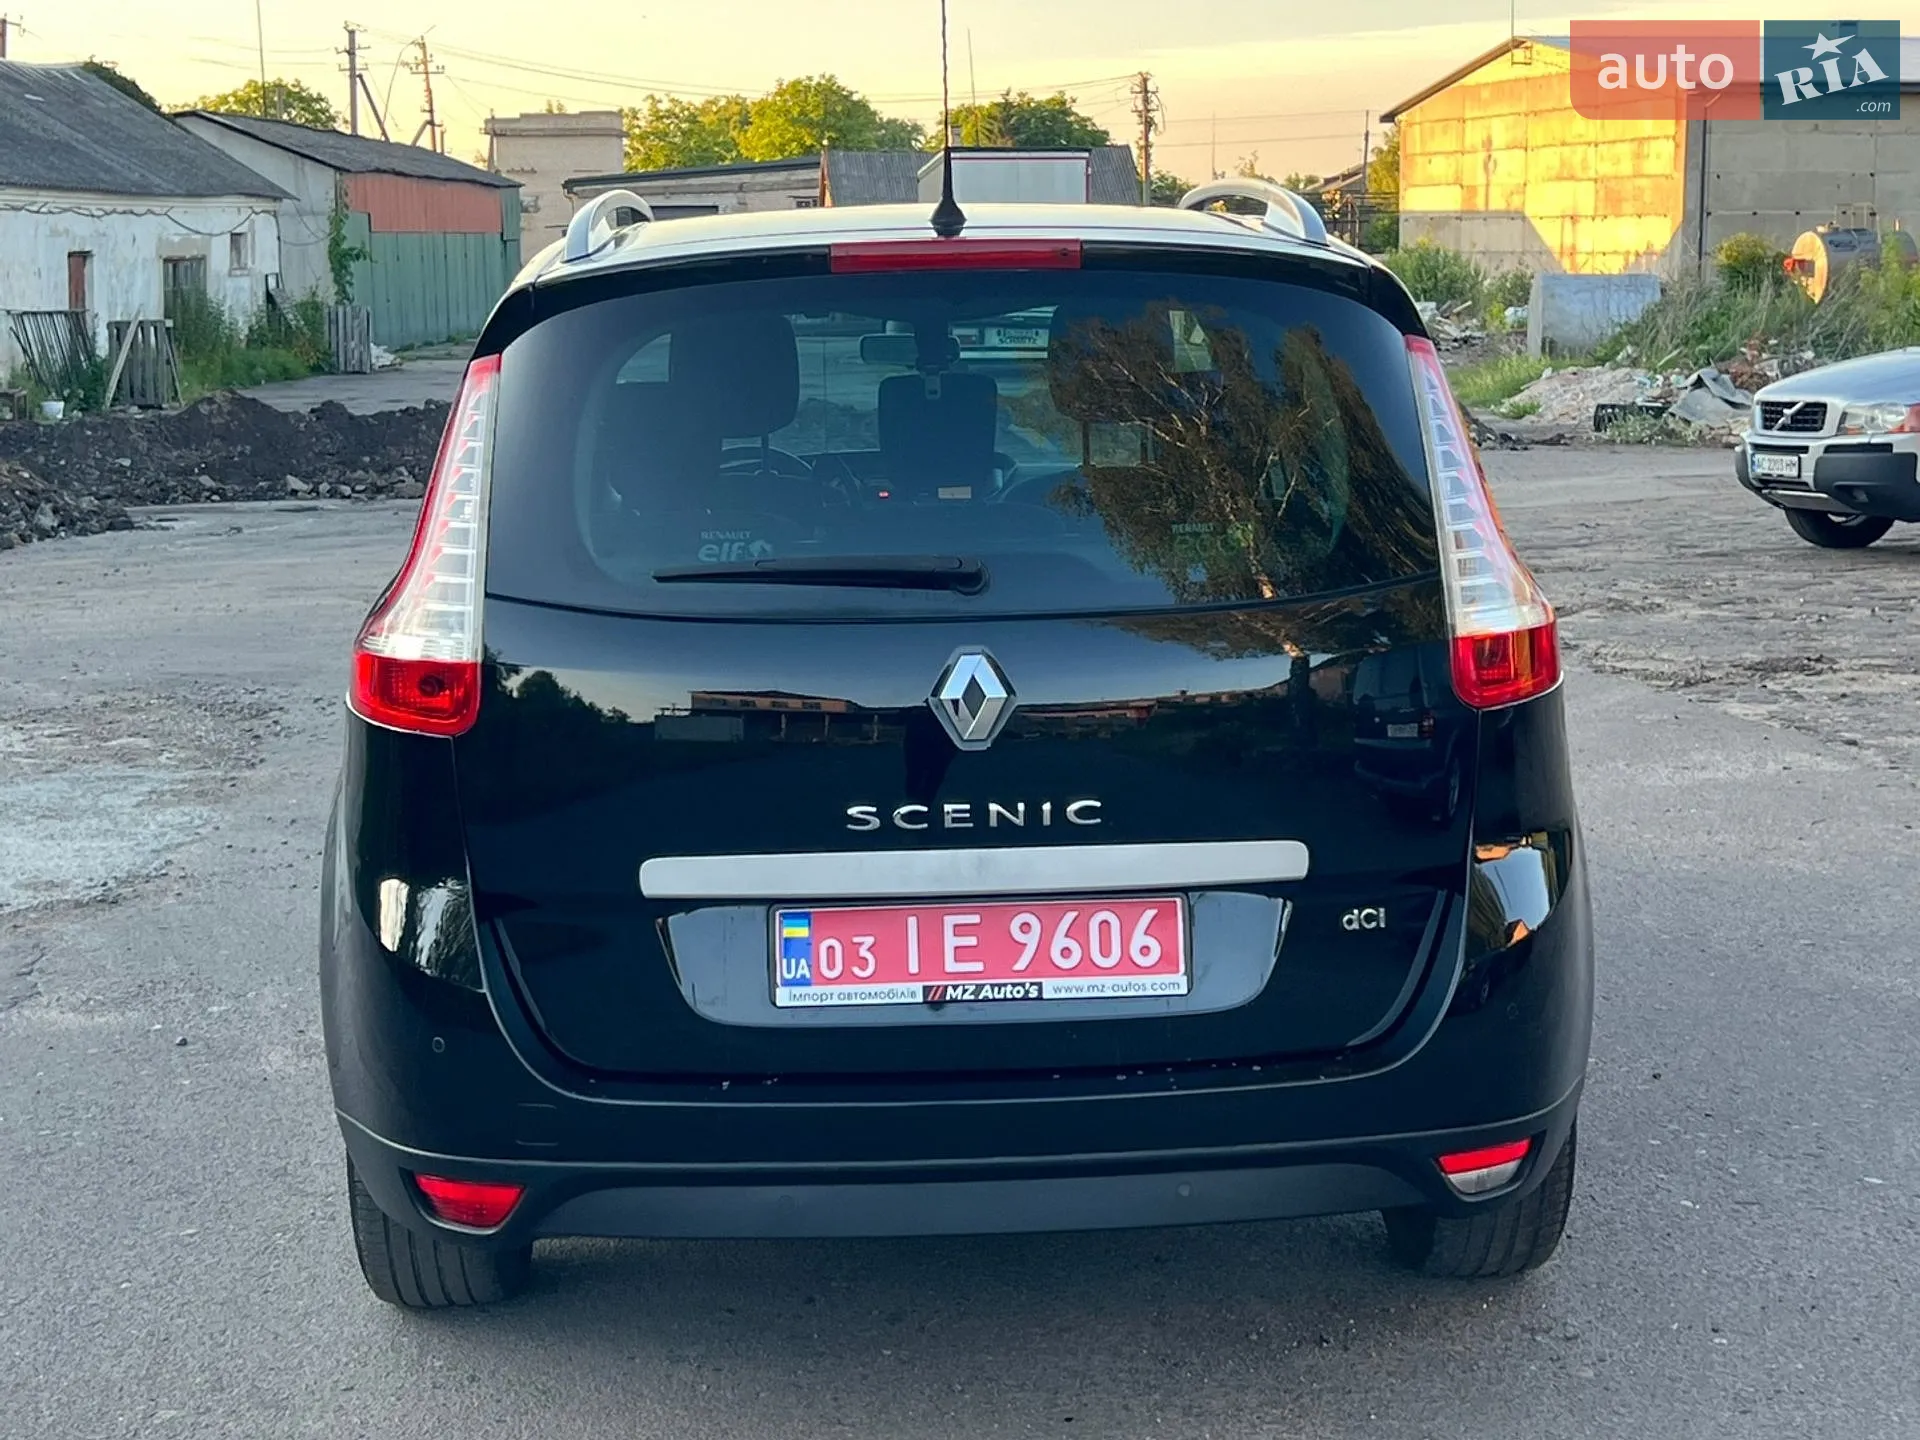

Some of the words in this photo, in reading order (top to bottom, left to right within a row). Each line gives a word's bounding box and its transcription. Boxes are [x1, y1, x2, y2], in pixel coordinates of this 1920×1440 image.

[701, 530, 751, 540] RENAULT
[698, 541, 746, 563] elf
[846, 800, 1102, 831] SCENIC
[819, 935, 876, 980] 03
[906, 912, 986, 976] IE
[1009, 907, 1163, 972] 9606
[782, 957, 811, 980] UA
[1053, 981, 1181, 994] www.mz-autos.com
